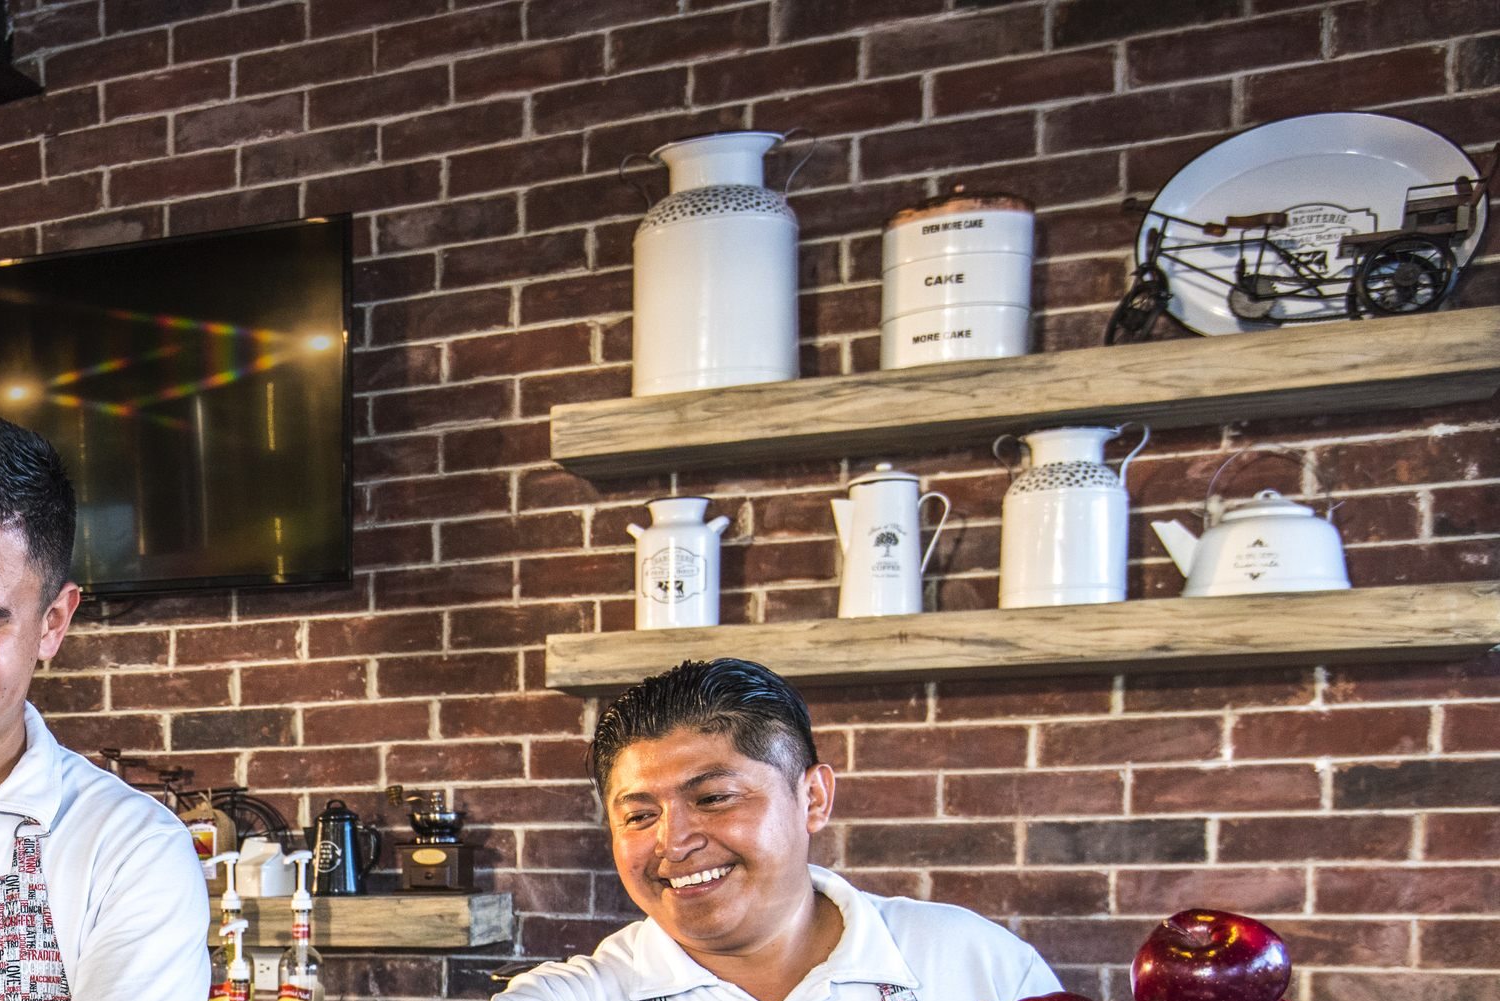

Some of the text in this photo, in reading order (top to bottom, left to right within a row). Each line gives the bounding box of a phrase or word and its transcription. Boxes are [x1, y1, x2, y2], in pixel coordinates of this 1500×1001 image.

[921, 219, 984, 235] EVEN MORE CAKE
[924, 273, 964, 287] CAKE
[912, 329, 972, 344] MORE CAKE
[4, 914, 36, 927] COFFEE
[7, 959, 21, 986] LOVE
[29, 975, 61, 984] MACCHIATO
